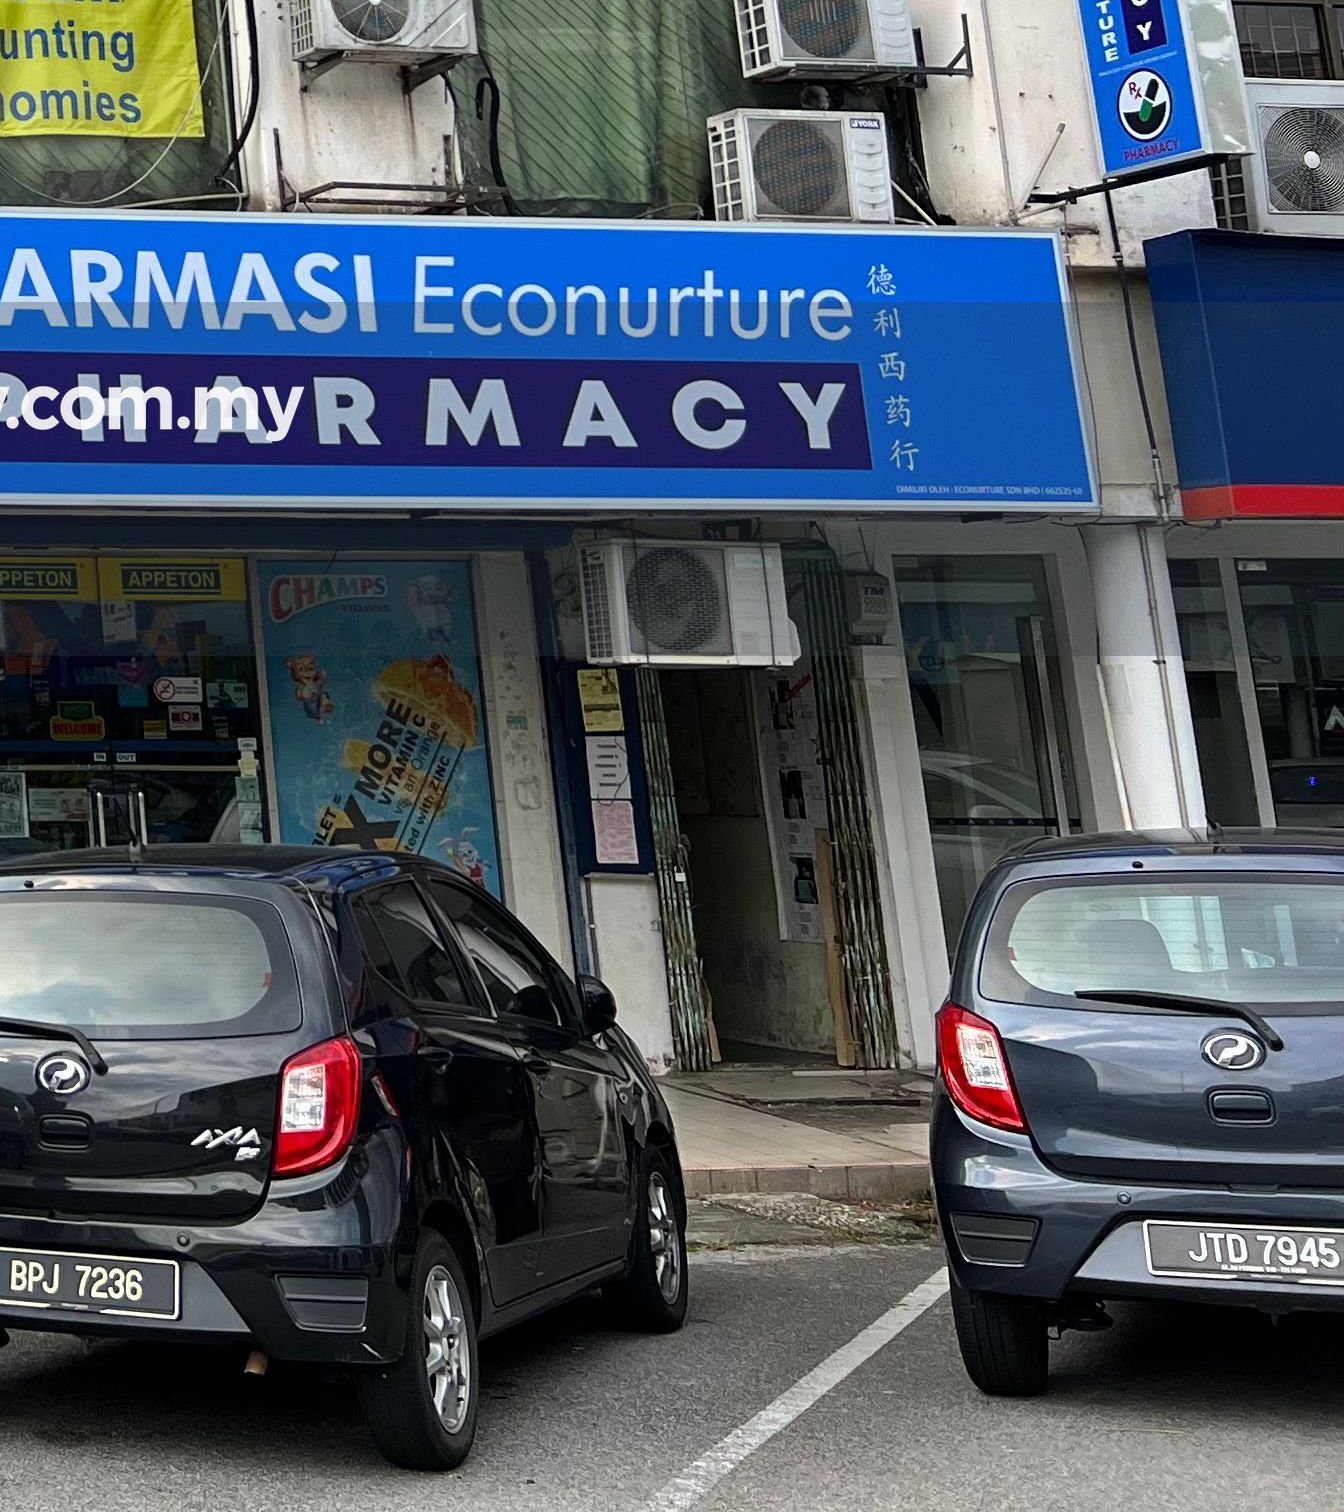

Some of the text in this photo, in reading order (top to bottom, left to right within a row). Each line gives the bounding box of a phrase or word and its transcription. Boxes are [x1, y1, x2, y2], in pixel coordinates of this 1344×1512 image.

[413, 255, 853, 341] Econurture
[867, 263, 919, 472] 德利西药行
[128, 571, 215, 587] APPETON
[270, 576, 387, 622] CHAMPS
[117, 753, 135, 761] OUT
[354, 697, 412, 800] MORE
[378, 712, 426, 805] VITAMIN C
[411, 719, 441, 770] Orange
[432, 757, 453, 792] ZINC
[1189, 1232, 1341, 1268] JTD 7945
[11, 1260, 143, 1301] BPJ 7236
